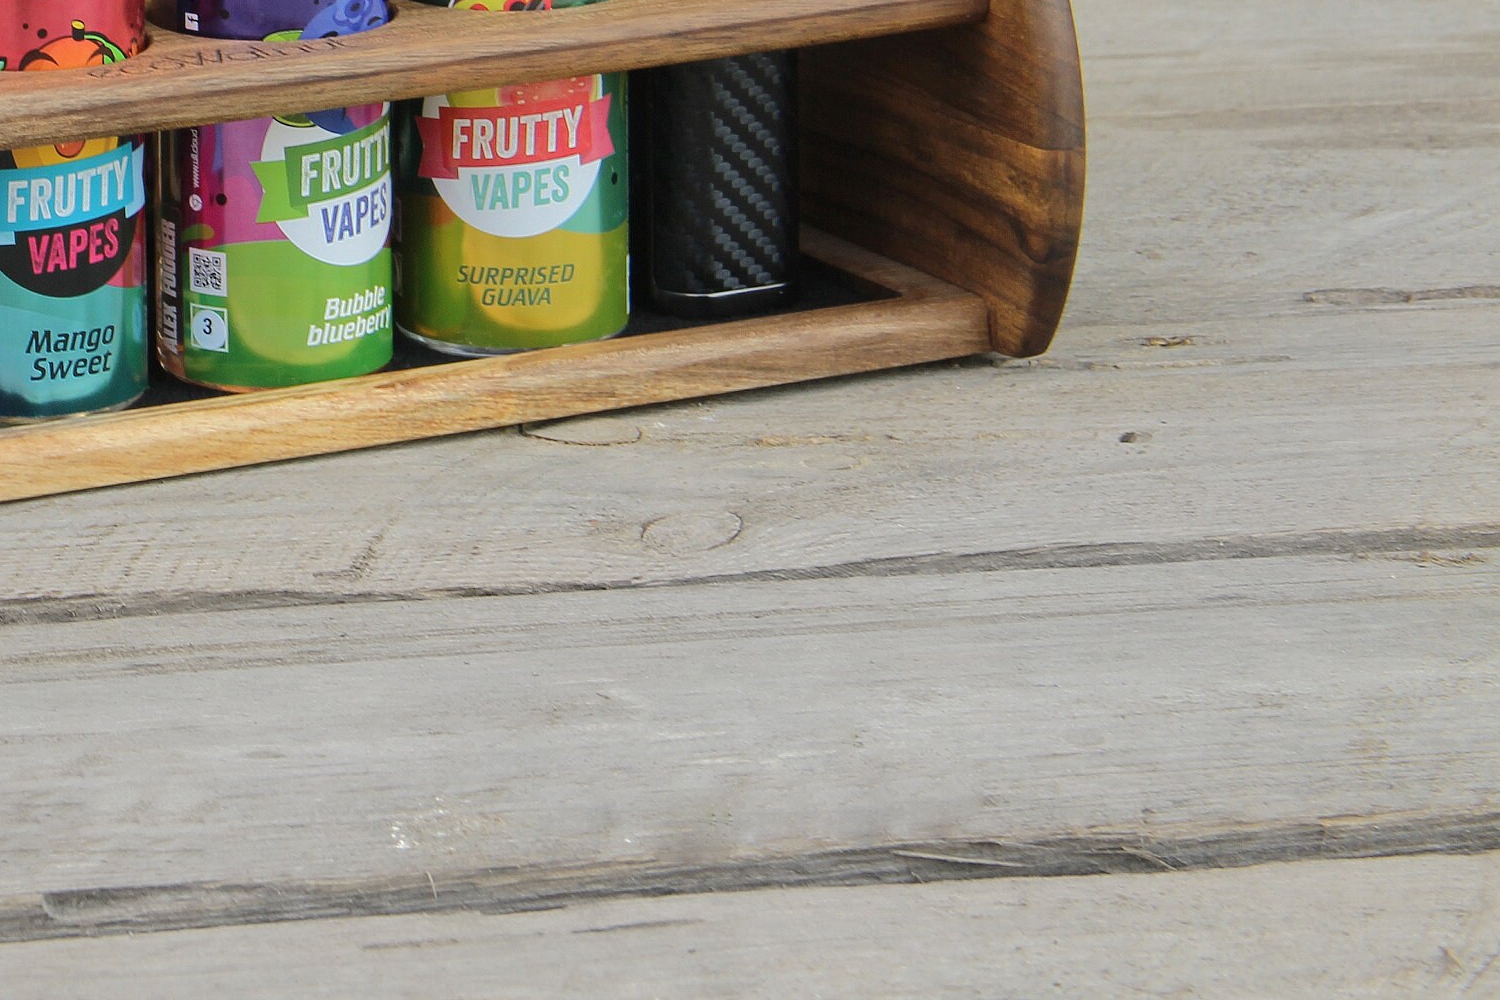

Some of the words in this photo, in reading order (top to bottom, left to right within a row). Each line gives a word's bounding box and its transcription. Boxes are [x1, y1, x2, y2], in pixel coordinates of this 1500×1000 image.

[452, 104, 583, 160] FRUTTY
[301, 121, 390, 197] FRUTTY
[7, 155, 129, 224] FRUTTY
[471, 164, 570, 211] VAPES
[320, 182, 387, 244] VAPES
[28, 218, 119, 275] VAPES
[457, 263, 575, 285] SURPRISED
[481, 287, 552, 307] GUAVA
[203, 317, 212, 335] 3
[324, 285, 386, 321] Bubble
[25, 324, 115, 355] Mango
[161, 301, 178, 355] ALEX
[30, 351, 112, 382] Sweet
